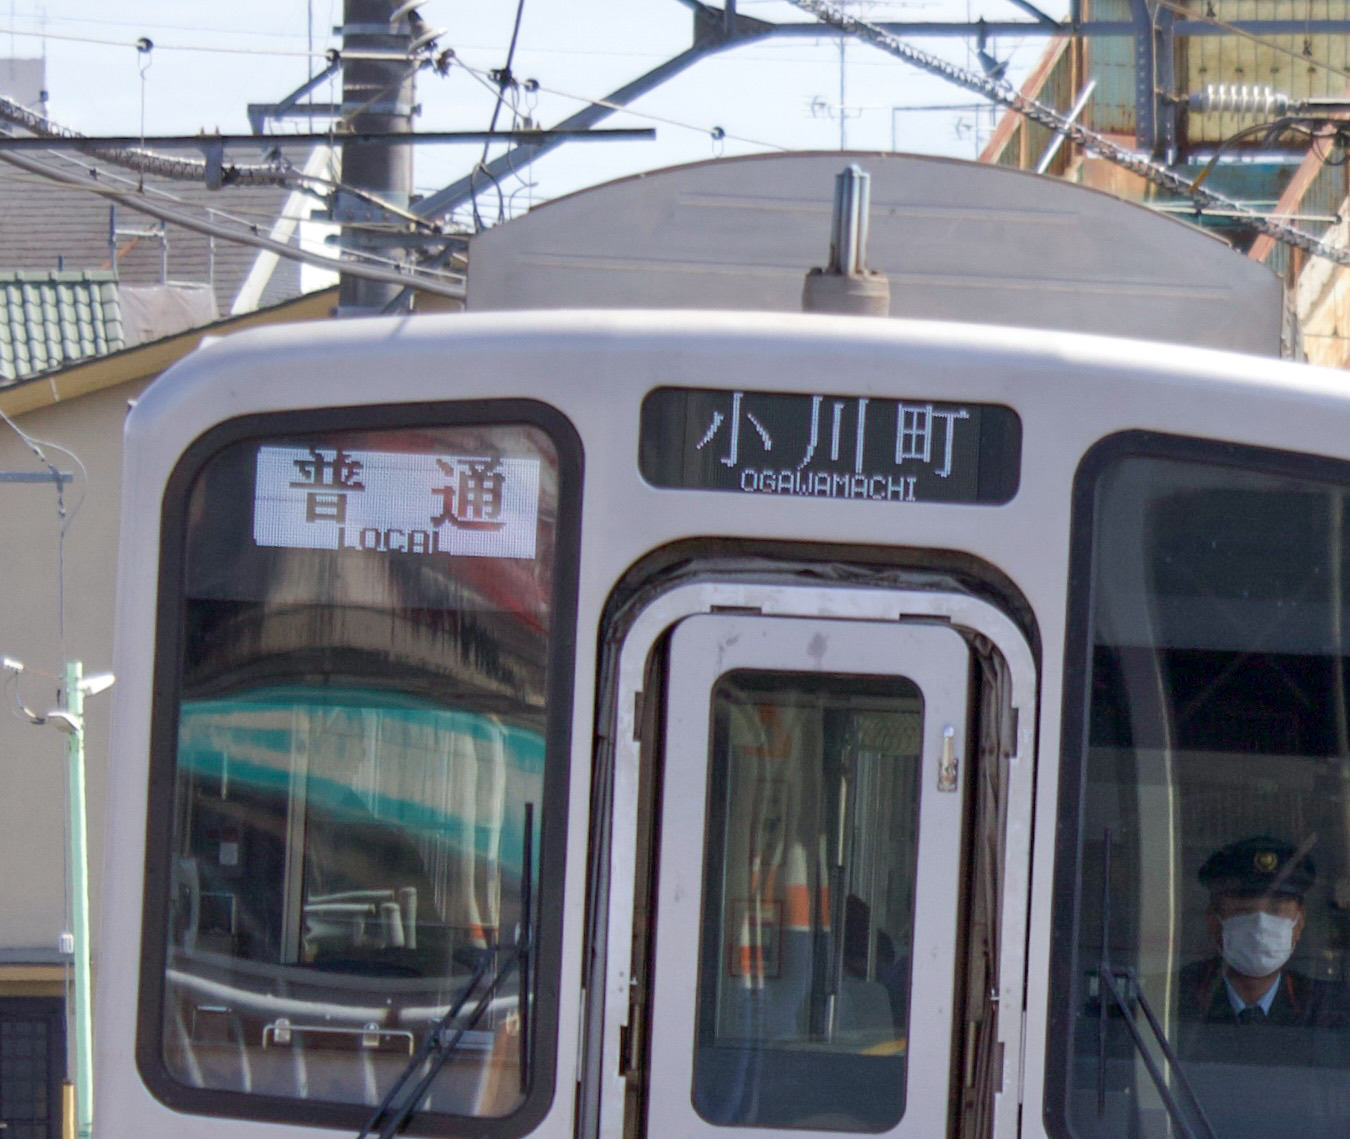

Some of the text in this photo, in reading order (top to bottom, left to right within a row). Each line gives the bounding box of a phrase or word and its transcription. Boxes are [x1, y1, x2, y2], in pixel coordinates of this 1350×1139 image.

[696, 392, 969, 477] 小川町
[289, 448, 506, 531] 普通
[741, 469, 917, 501] OGAWAMACHI
[338, 527, 450, 554] LOCAL
